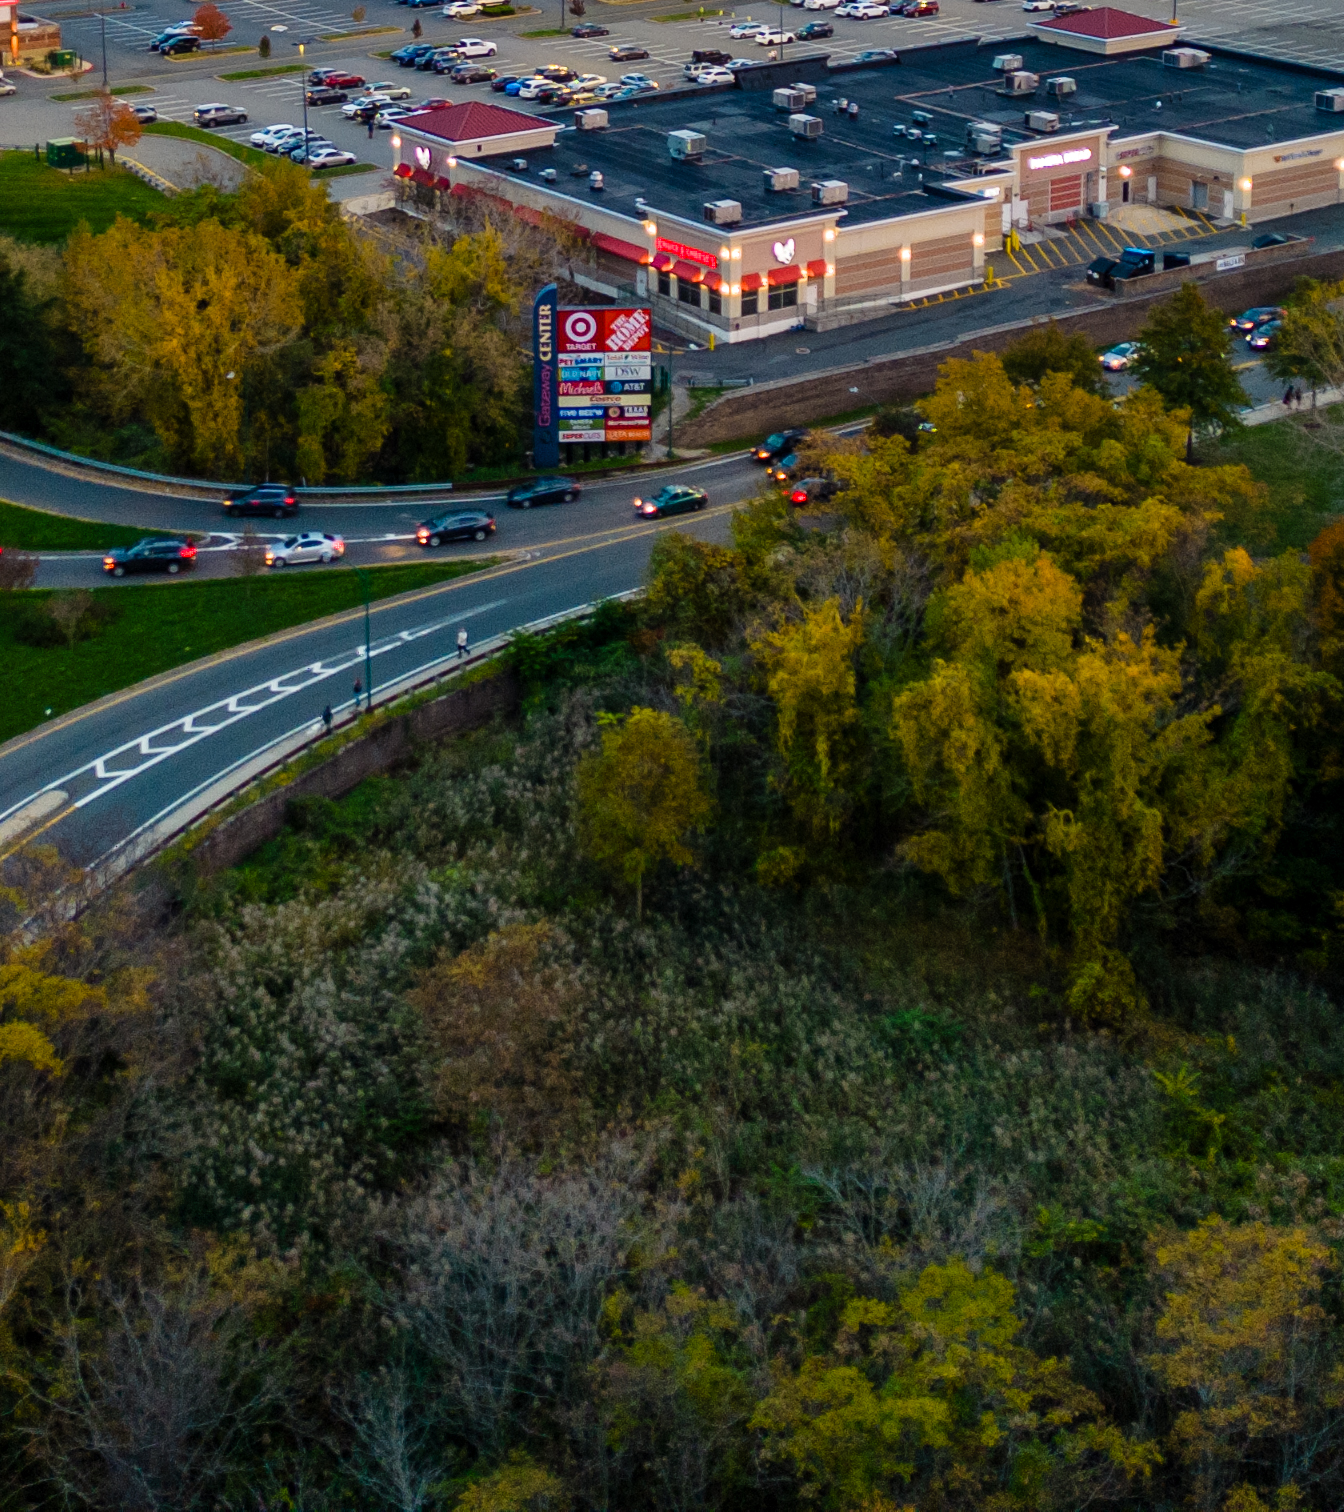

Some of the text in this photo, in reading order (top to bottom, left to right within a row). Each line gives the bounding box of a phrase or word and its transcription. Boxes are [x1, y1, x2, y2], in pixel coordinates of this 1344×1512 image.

[539, 304, 552, 361] CENTER
[605, 309, 649, 350] HOME
[622, 322, 649, 350] DEPOT
[566, 343, 596, 351] TARGET
[615, 367, 642, 377] DSW
[538, 363, 553, 426] Gateway
[559, 381, 604, 395] Michaels
[623, 382, 645, 391] AT&T
